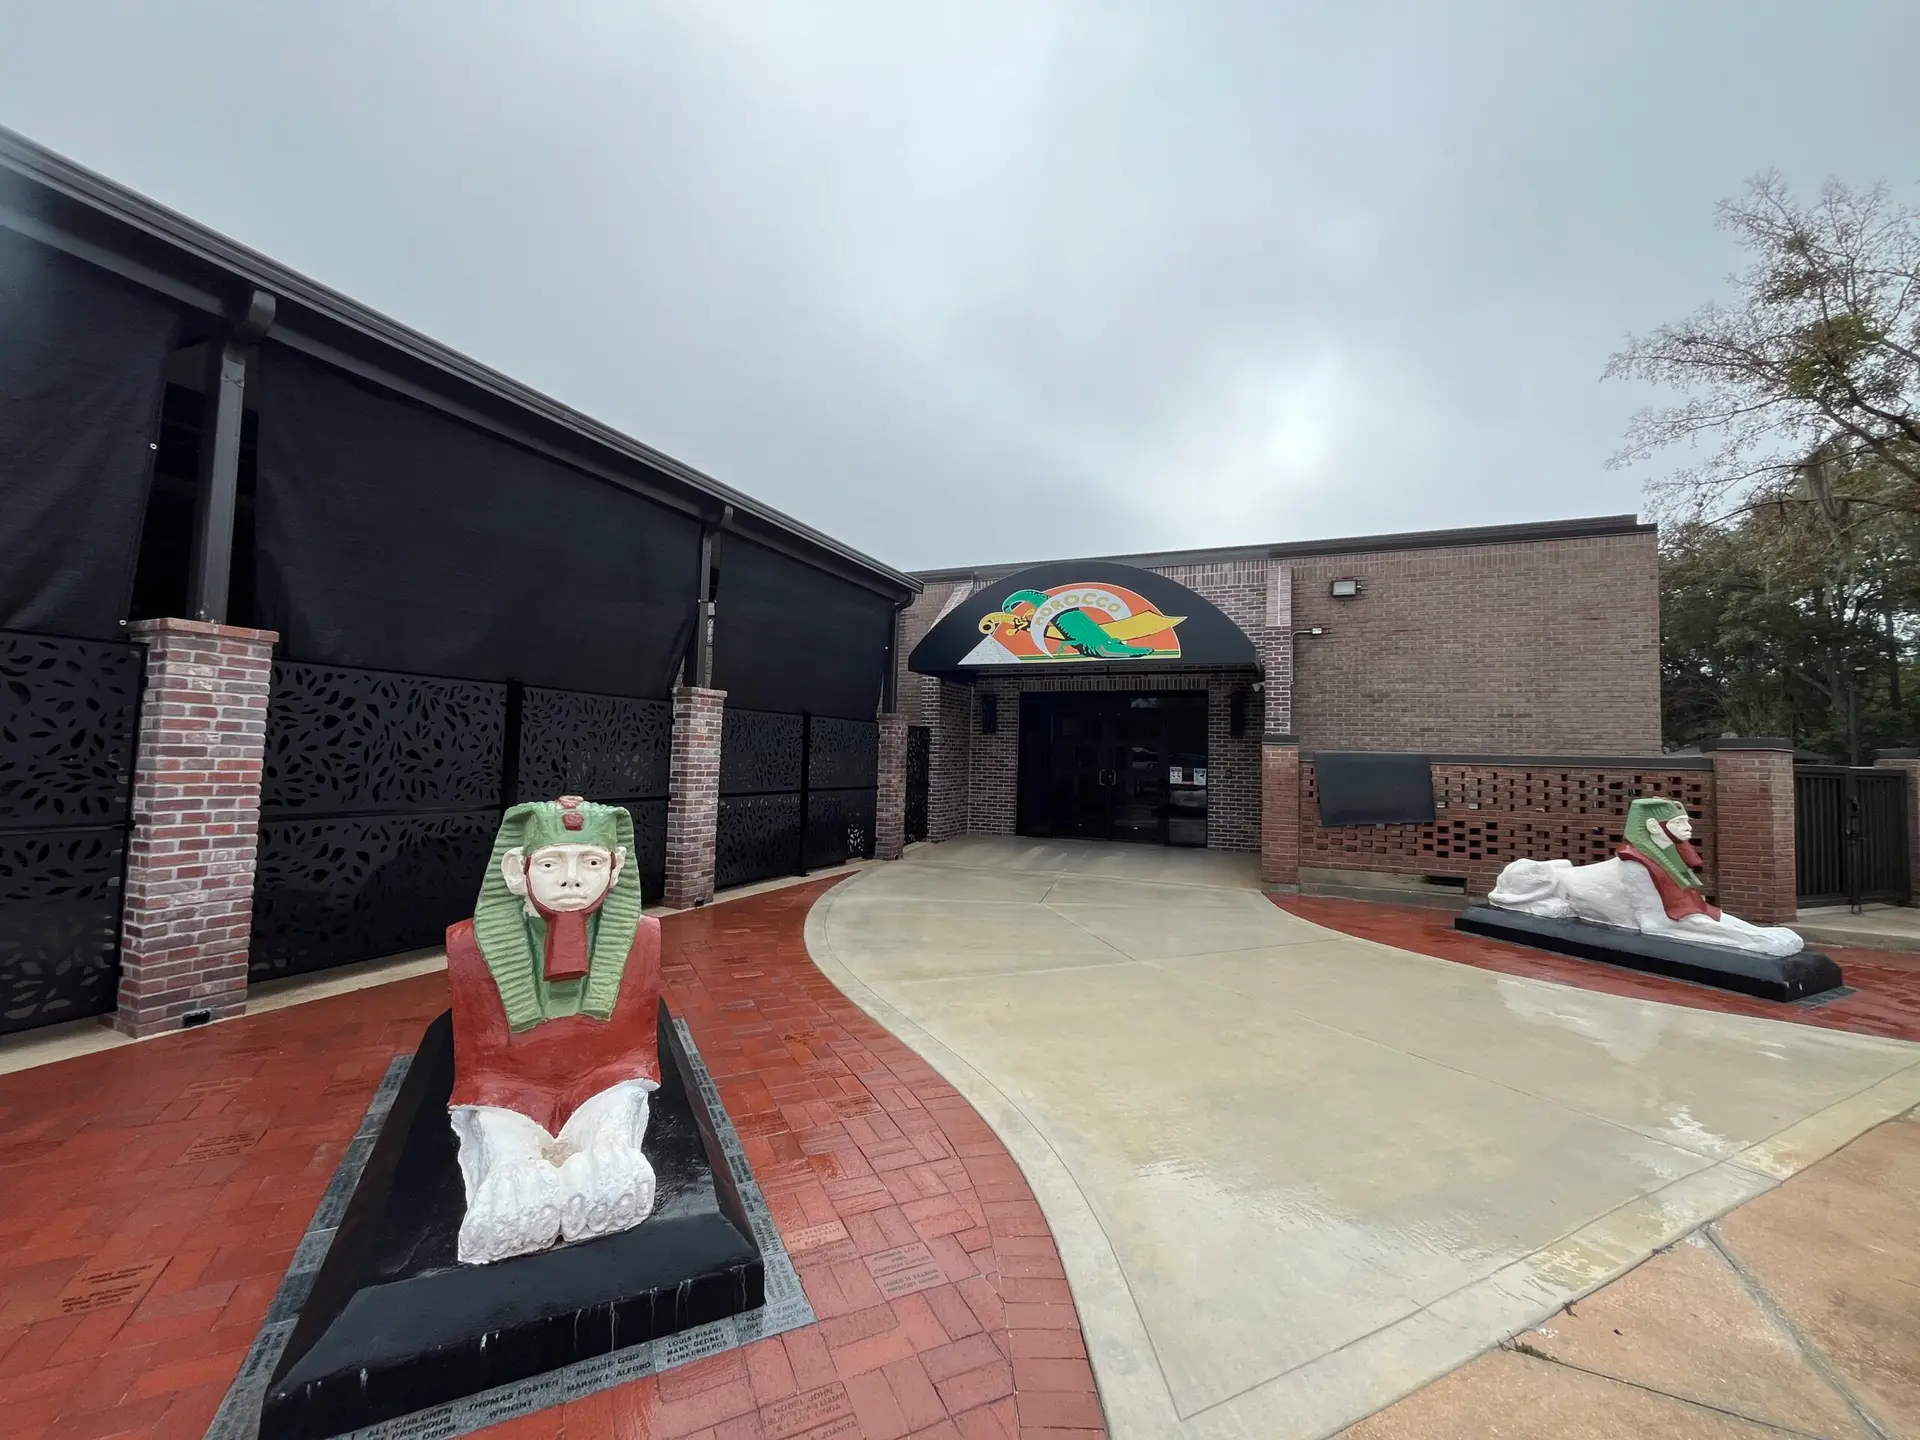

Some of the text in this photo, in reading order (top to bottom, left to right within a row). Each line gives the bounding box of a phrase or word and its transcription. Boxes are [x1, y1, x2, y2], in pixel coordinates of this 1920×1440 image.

[666, 1344, 689, 1356] MARY
[668, 1335, 692, 1347] LOUIS
[576, 1353, 640, 1376] PRAISE GOD
[566, 1376, 602, 1392] MARVIN
[615, 1361, 651, 1378] ALFORD
[468, 1380, 559, 1411] THOMAS FOSTER
[808, 1387, 834, 1401] JOHN
[394, 1405, 454, 1429] CHILDREN
[488, 1399, 533, 1418] WRIGHT
[392, 1415, 452, 1439] PRECIOUS
[422, 1424, 457, 1440] ODOM
